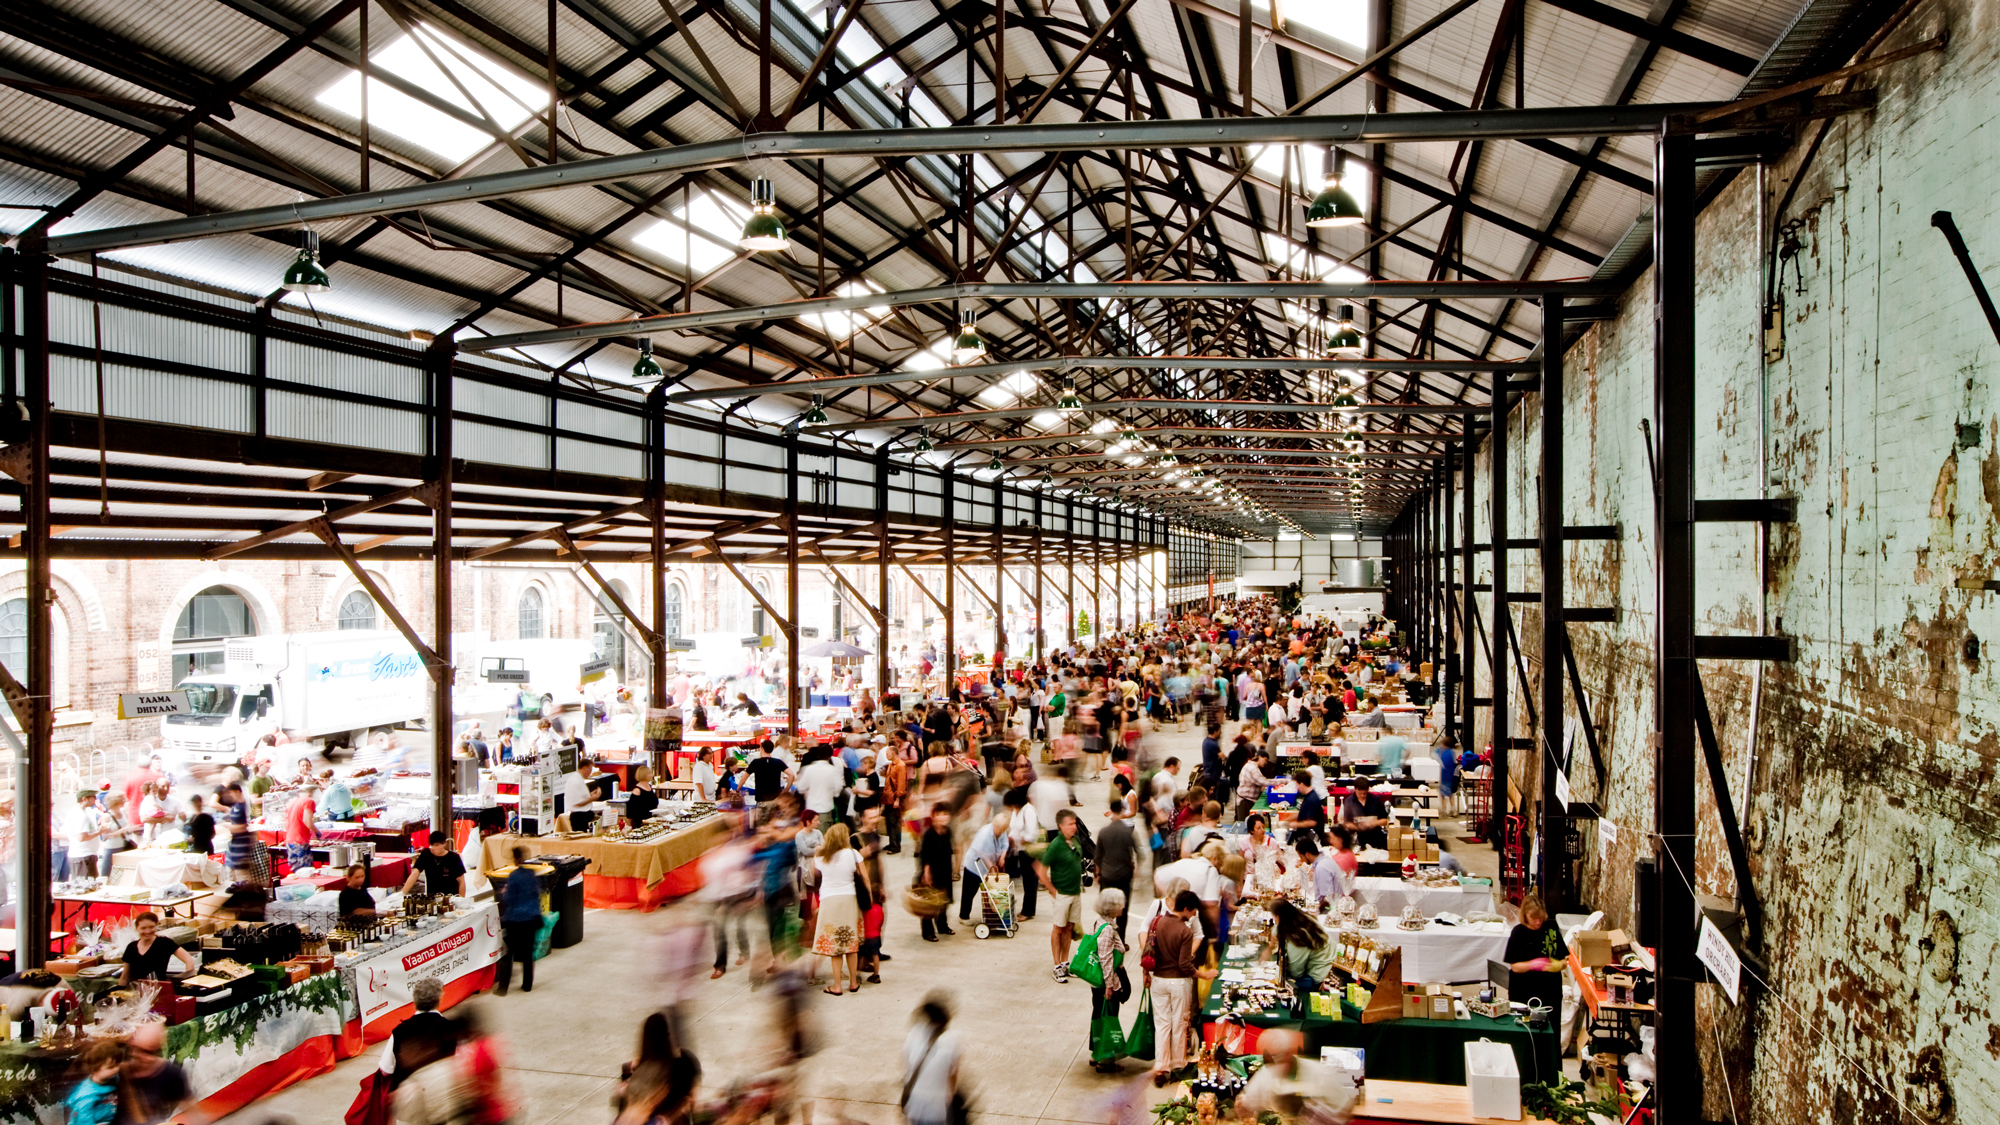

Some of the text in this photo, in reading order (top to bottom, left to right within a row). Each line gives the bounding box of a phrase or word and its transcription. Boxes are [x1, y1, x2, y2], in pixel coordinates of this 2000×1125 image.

[139, 649, 158, 658] 052
[371, 652, 418, 682] Taste
[137, 705, 177, 714] DHIYAAN
[139, 696, 171, 704] YAAMA
[405, 948, 435, 967] Yaama
[436, 931, 471, 954] Dhiyaan
[1707, 928, 1735, 973] WINDY HILL
[1705, 947, 1732, 989] ORCHARDS
[204, 1002, 249, 1033] Bago
